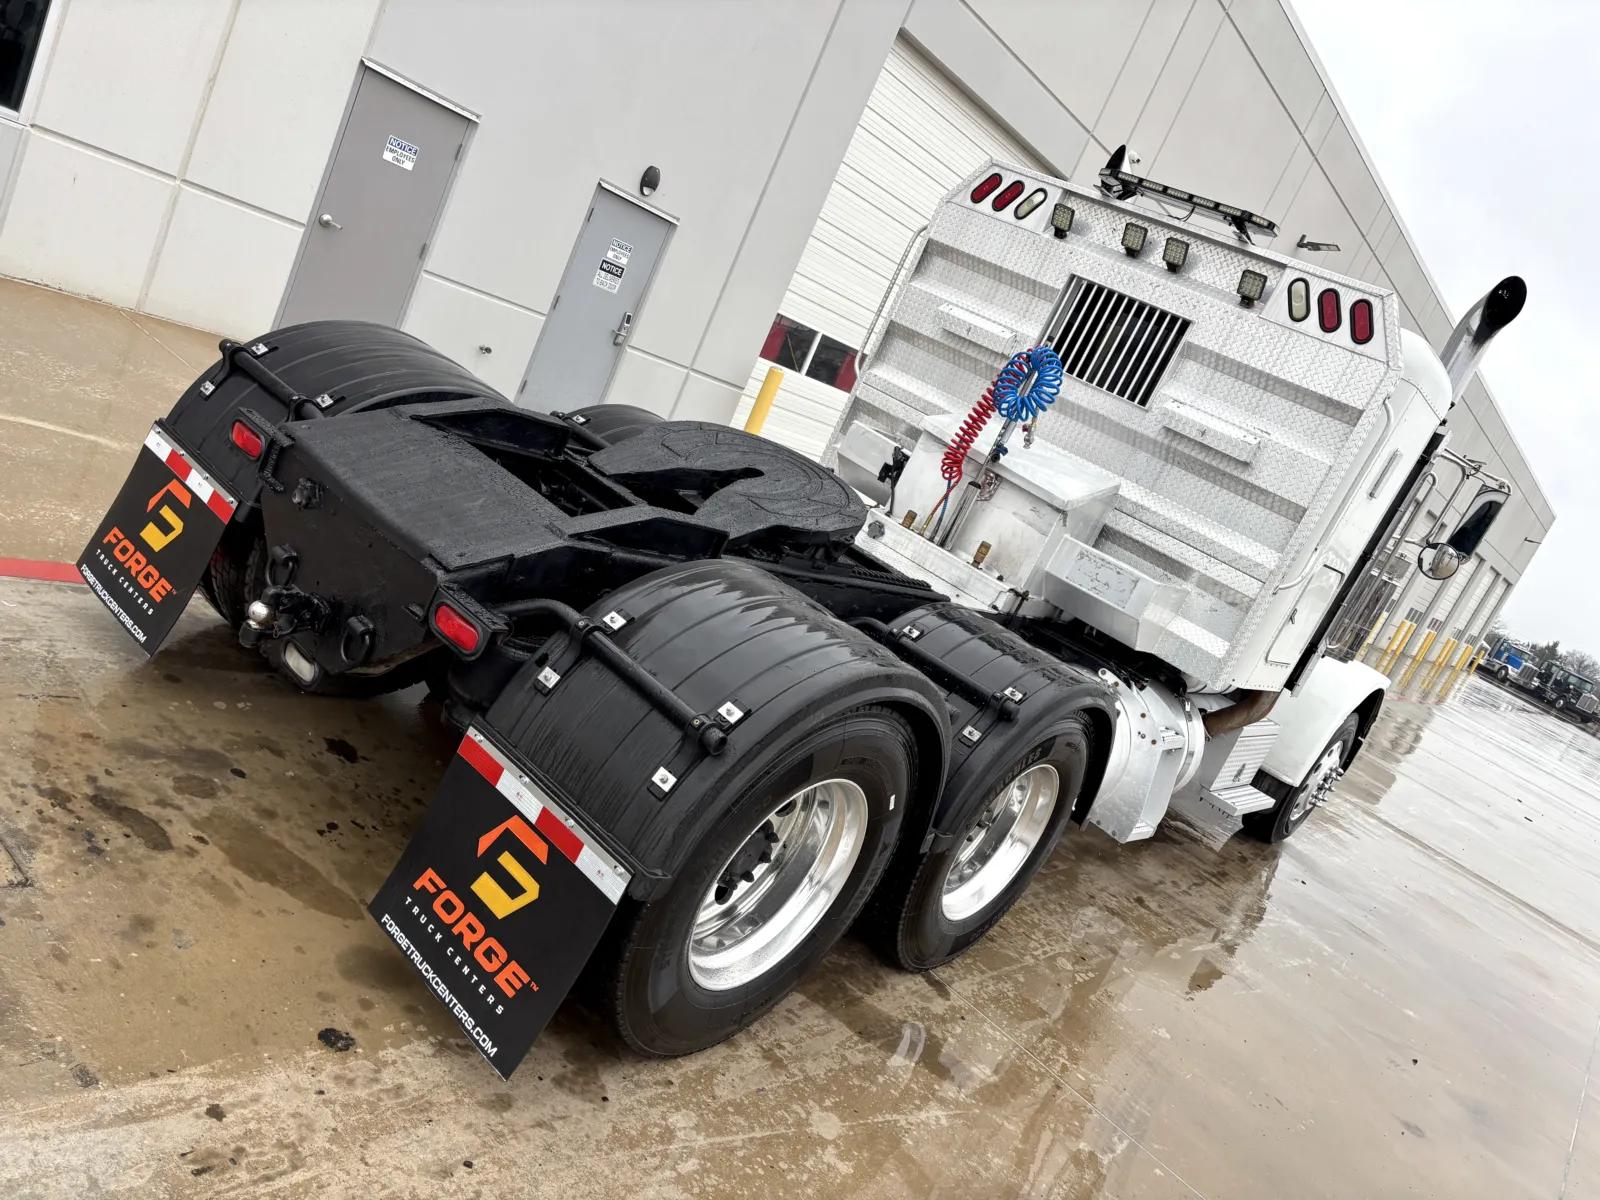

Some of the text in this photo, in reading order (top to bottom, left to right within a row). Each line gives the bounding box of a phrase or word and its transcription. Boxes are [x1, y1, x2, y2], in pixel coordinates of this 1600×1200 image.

[386, 146, 415, 163] EMPLOYEES
[389, 138, 416, 156] NOTICE
[391, 155, 405, 165] ONLY
[601, 261, 622, 276] NOTICE
[611, 239, 632, 253] NOTICE
[96, 549, 153, 615] TRUCK CENTERS
[103, 527, 172, 603] FORGE
[80, 563, 147, 643] FORGETRUCKCENTERS.COM
[405, 896, 504, 1015] TRUCK CENTERS
[413, 867, 530, 998] FORGE
[381, 914, 498, 1057] FORGETRUCKCENTERS.COM
